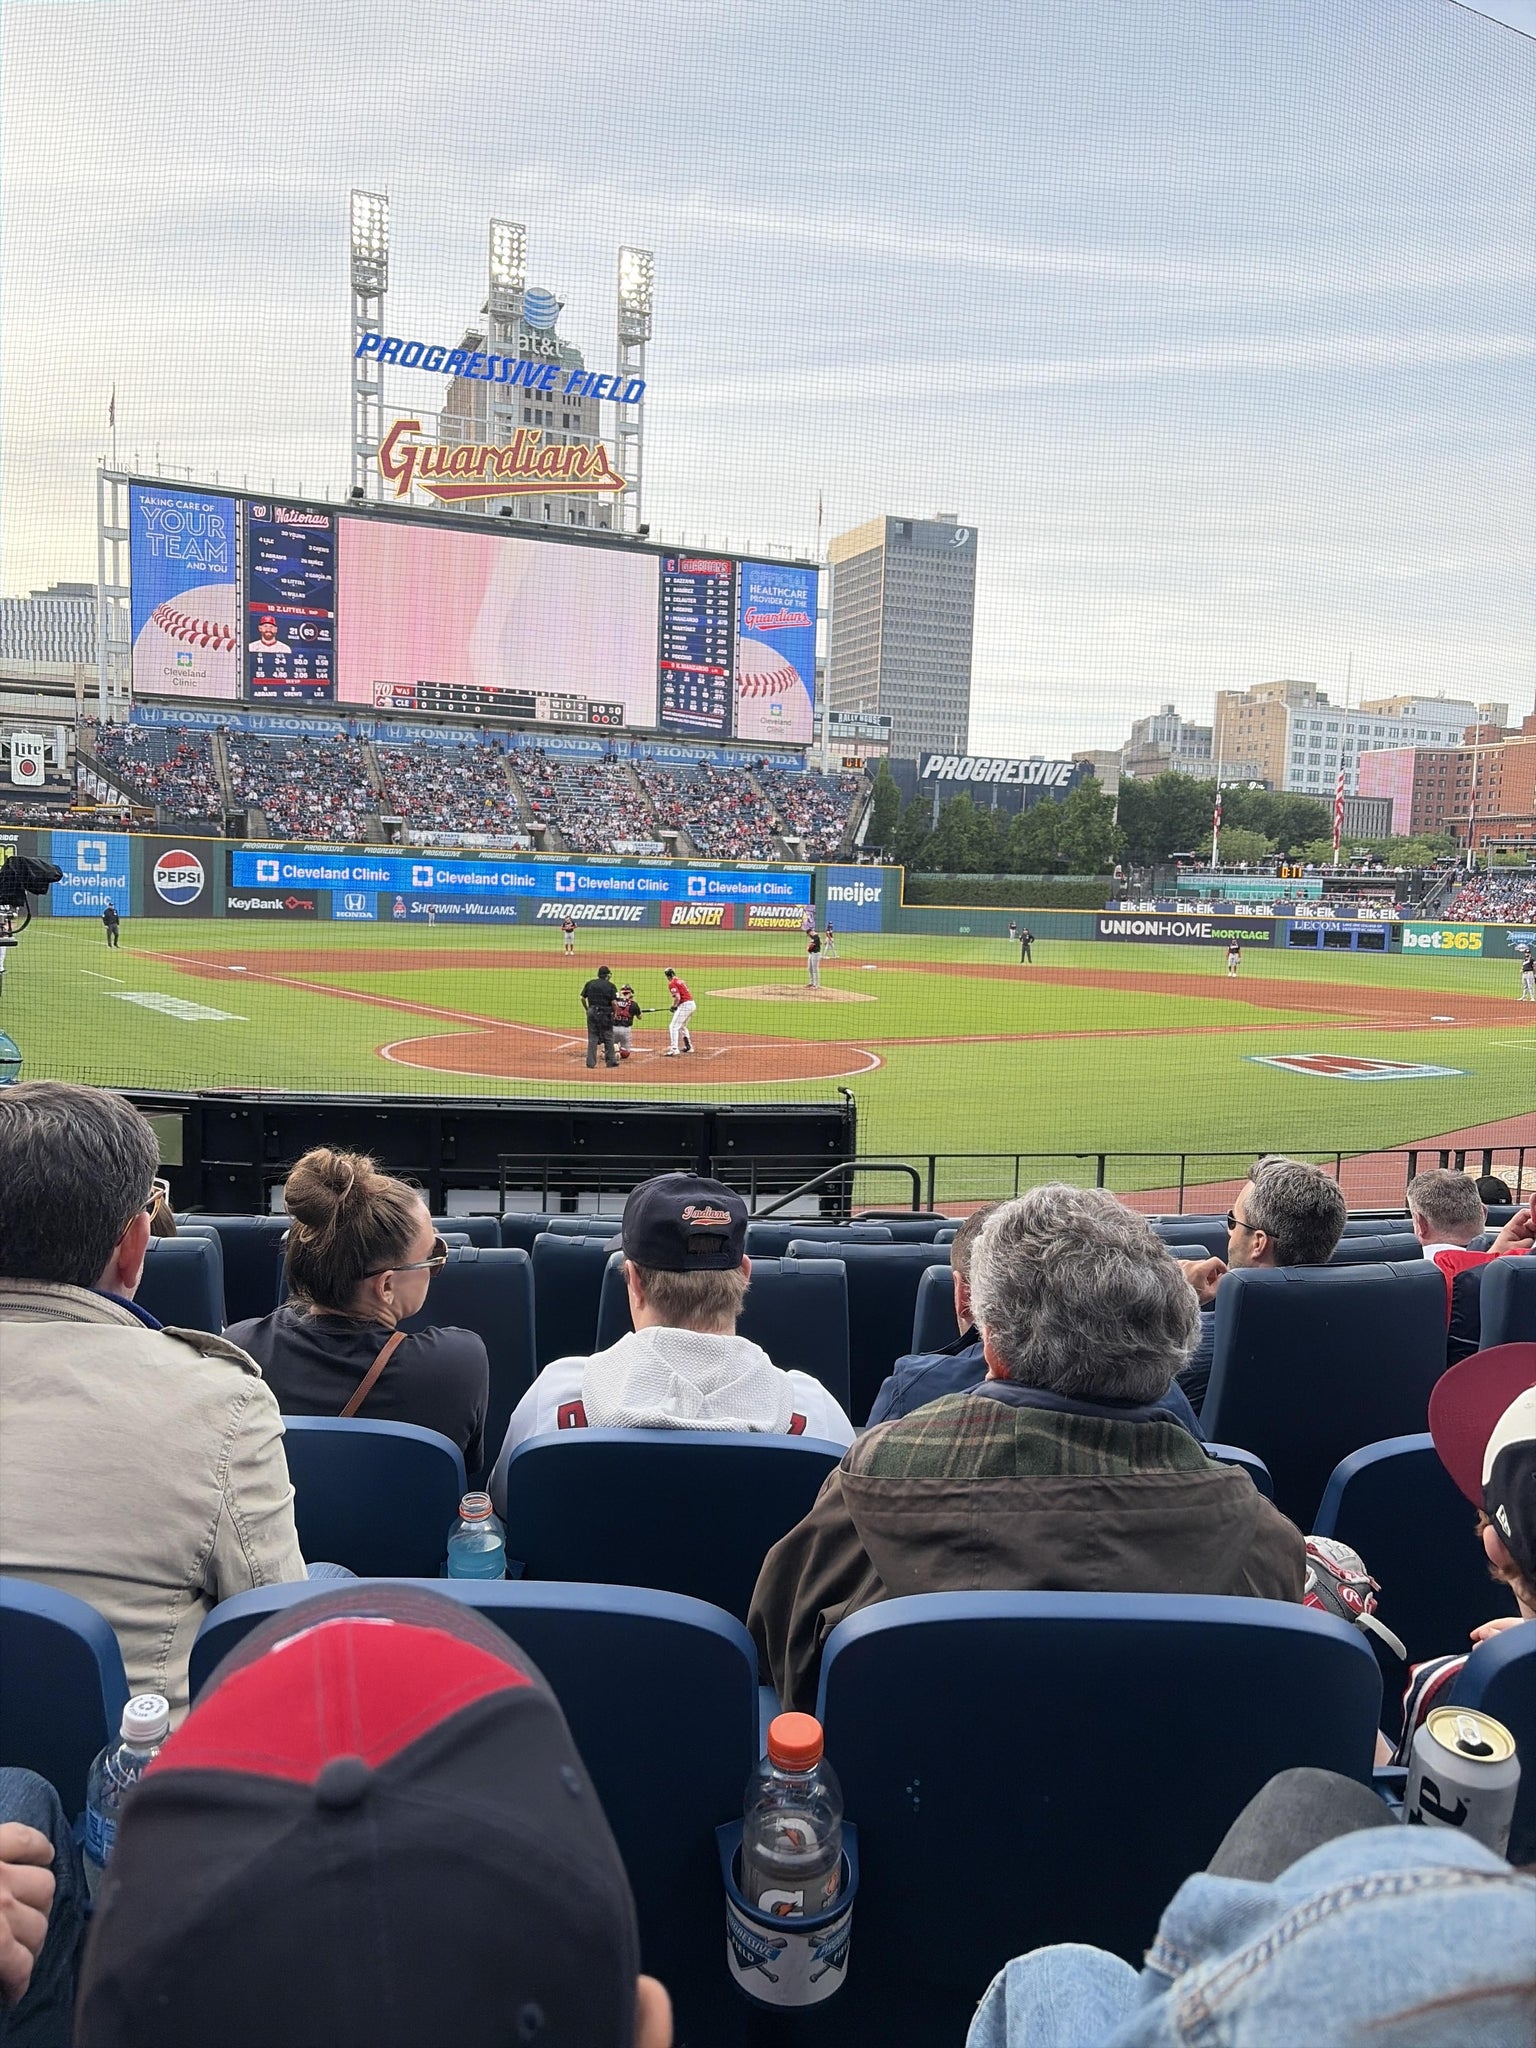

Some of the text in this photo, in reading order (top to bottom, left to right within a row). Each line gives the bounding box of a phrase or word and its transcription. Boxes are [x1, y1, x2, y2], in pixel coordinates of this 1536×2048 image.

[518, 334, 564, 359] at&t
[354, 332, 646, 404] PROGRESSIVE FIELD
[378, 418, 627, 503] Guardians
[140, 495, 215, 512] TAKING CARE OF
[140, 506, 226, 539] YOUR
[275, 506, 330, 528] Nationals
[146, 532, 228, 564] TEAM
[187, 562, 228, 573] AND YOU
[681, 559, 729, 573] GUARDIANS
[749, 584, 808, 600] HEALTHCARE
[750, 594, 808, 608] PROVIDER OF THE
[744, 605, 813, 631] Guardians
[289, 627, 298, 635] 21
[304, 628, 315, 636] 63
[163, 667, 207, 679] Cleveland
[172, 678, 197, 688] Clinic
[395, 687, 411, 696] WAS
[435, 690, 441, 698] 3
[395, 699, 409, 707] CLE
[421, 701, 427, 709] 0
[448, 703, 454, 711] 0
[475, 705, 481, 713] 0
[599, 705, 605, 714] 0
[615, 707, 622, 715] 0
[162, 710, 243, 727] HONDA
[269, 717, 346, 733] HONDA
[760, 717, 791, 726] Cleveland
[405, 727, 478, 743] HONDA
[766, 725, 785, 734] Clinic
[15, 742, 42, 758] Lite
[537, 738, 603, 752] HONDA
[655, 746, 719, 760] HONDA
[738, 752, 799, 766] HONDA
[921, 755, 1075, 787] PROGRESSIVE
[242, 842, 286, 850] PROGRESSIVE
[303, 845, 346, 853] PROGRESSIVE
[364, 847, 406, 855] PROGRESSIVE
[422, 849, 463, 857] PROGRESSIVE
[157, 871, 201, 883] PEPSI
[282, 865, 390, 881] Cleveland Clinic
[436, 870, 536, 887] Cleveland Clinic
[59, 875, 125, 887] Cleveland
[577, 876, 670, 891] Cleveland Clinic
[708, 880, 793, 895] Cleveland Clinic
[72, 892, 112, 906] Clinic
[827, 881, 882, 906] meijer
[227, 897, 284, 911] KeyBank
[749, 905, 804, 917] PHANTOM
[536, 903, 645, 921] PROGRESSIVE
[671, 906, 724, 925] BLASTER
[748, 917, 803, 928] FIREWORKS
[1211, 929, 1269, 940] MORTGAGE
[1402, 929, 1483, 950] bet365
[681, 1205, 732, 1226] Indians
